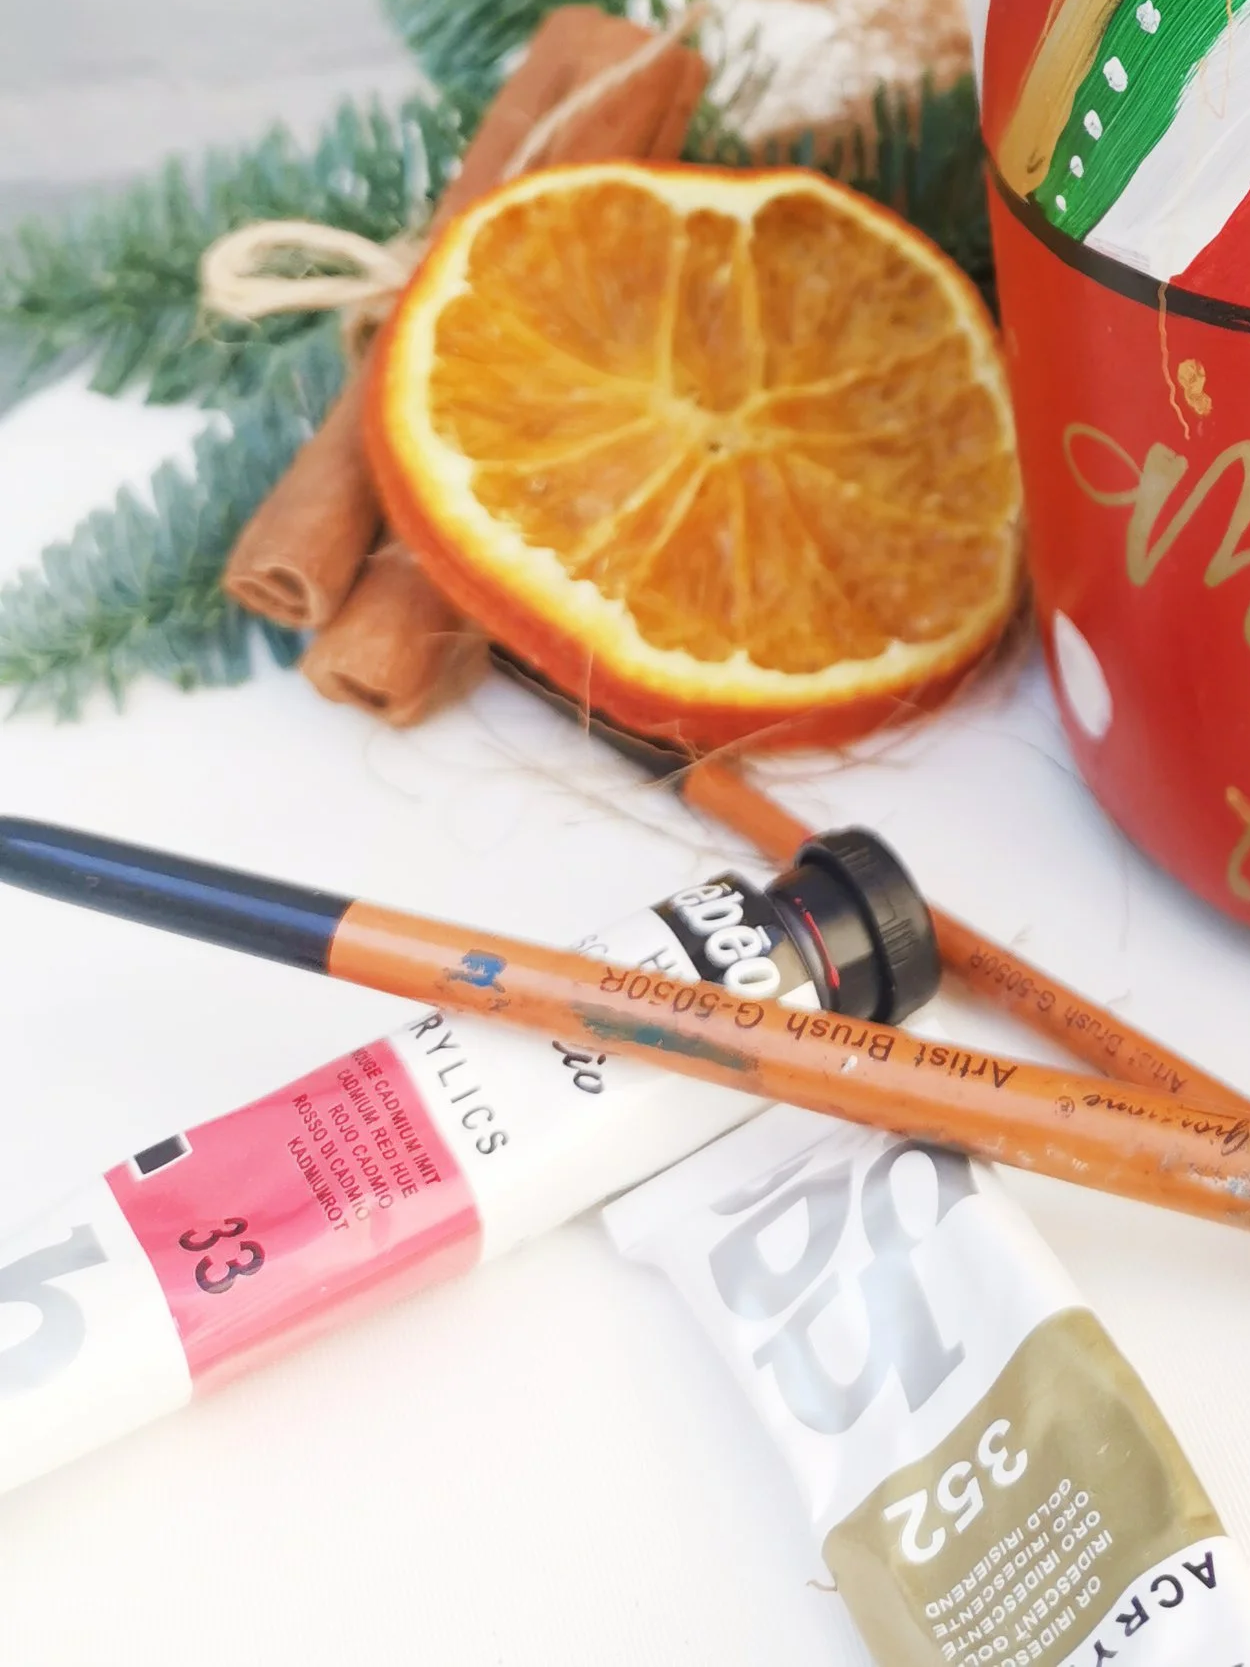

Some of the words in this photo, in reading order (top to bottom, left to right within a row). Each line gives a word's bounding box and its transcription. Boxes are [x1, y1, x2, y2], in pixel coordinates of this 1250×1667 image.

[599, 966, 765, 1031] G-5050R
[786, 1012, 897, 1063] Brush
[1064, 1003, 1127, 1059] Brush
[410, 1012, 509, 1155] RYLICS
[913, 1042, 1019, 1090] Artist
[291, 1093, 328, 1143] ROSSO
[320, 1140, 338, 1161] DI
[329, 1158, 371, 1222] CADMIO
[328, 1103, 360, 1143] ROJO
[352, 1144, 394, 1210] CADMIO
[336, 1068, 381, 1126] CADMIUM
[370, 1126, 398, 1161] RED
[389, 1160, 419, 1199] HUE
[374, 1080, 422, 1157] CADMIUM
[412, 1149, 442, 1185] IMIT
[287, 1135, 350, 1232] KADMIUMROT
[178, 1216, 266, 1295] 33
[883, 1418, 1028, 1564] 352
[1027, 1478, 1072, 1530] GOLD
[1052, 1490, 1089, 1533] ORO
[1061, 1510, 1101, 1552] ORO
[924, 1526, 1024, 1619] IRISIEREND
[932, 1531, 1050, 1639] IRIDESCENTE
[940, 1549, 1061, 1662] IRIDESCENTE
[1014, 1529, 1113, 1643] IRIDESCENT
[1075, 1576, 1101, 1609] OR
[1088, 1550, 1218, 1667] ACRY
[994, 1605, 1076, 1667] IRIDESC
